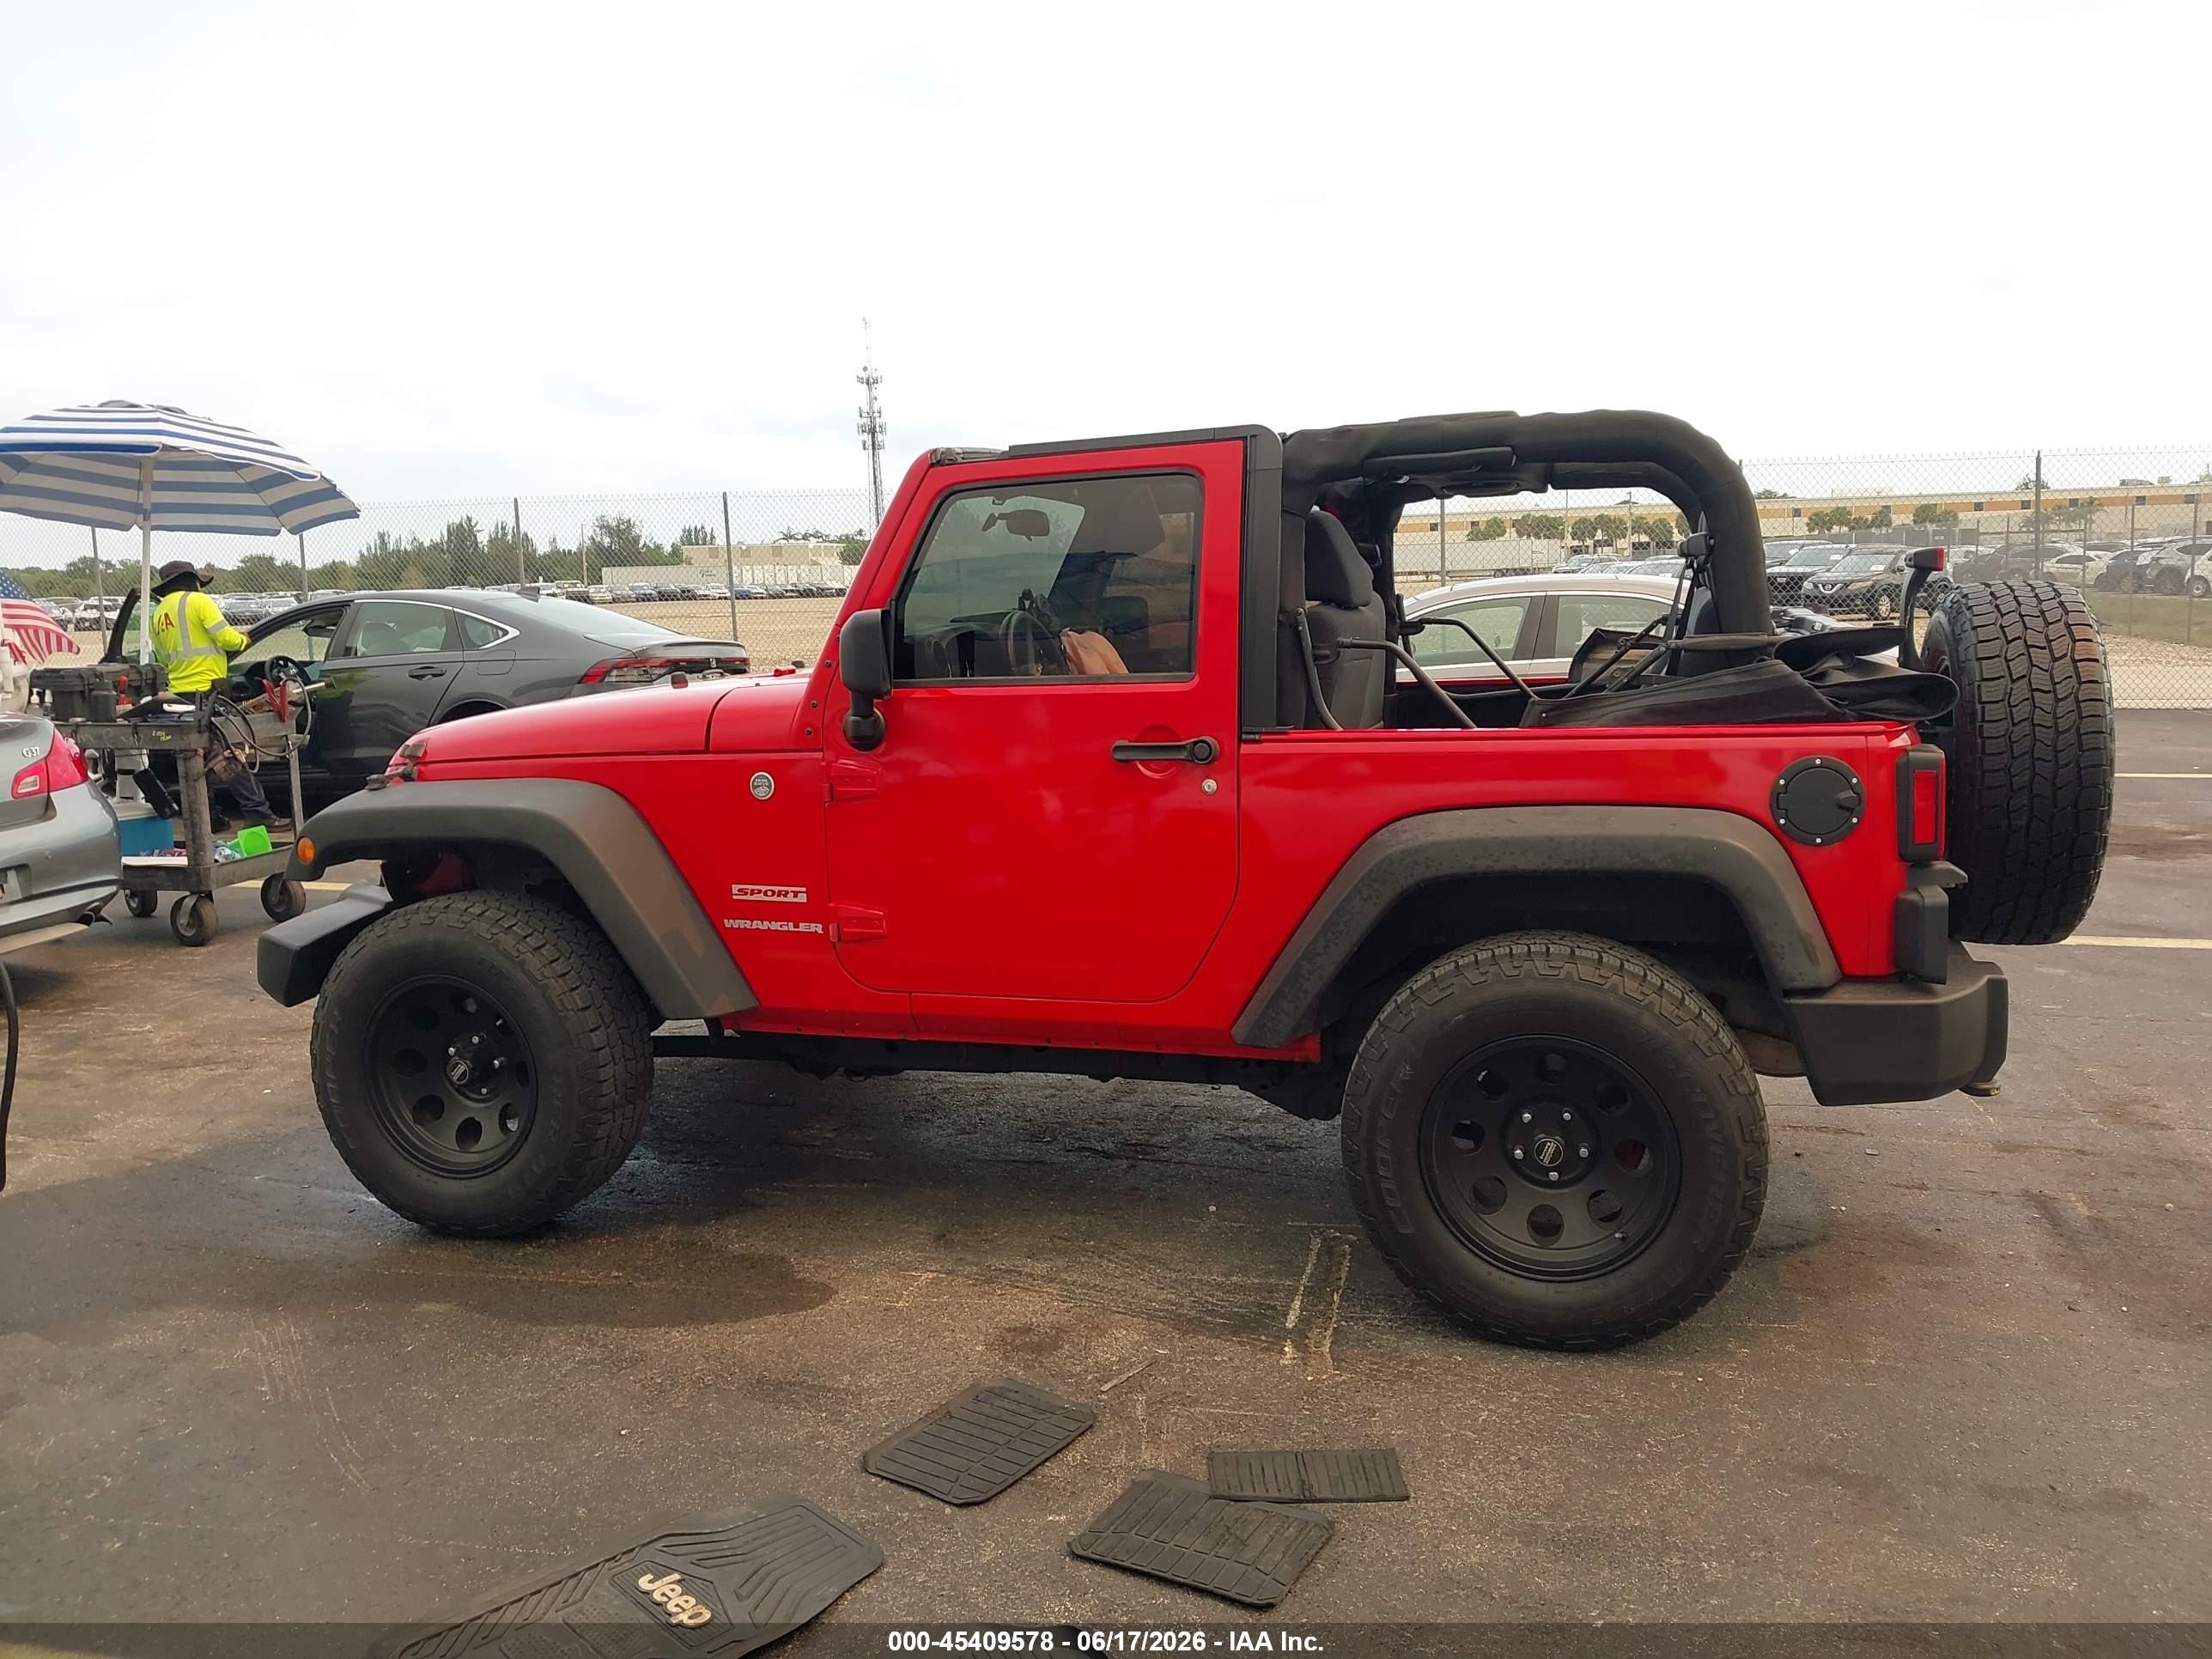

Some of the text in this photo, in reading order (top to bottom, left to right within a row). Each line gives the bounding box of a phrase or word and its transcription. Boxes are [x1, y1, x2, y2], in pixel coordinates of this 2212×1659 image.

[22, 746, 40, 757] G37
[733, 886, 805, 900] SPORT
[724, 919, 824, 934] WRANGLER
[638, 1573, 712, 1626] Jeep
